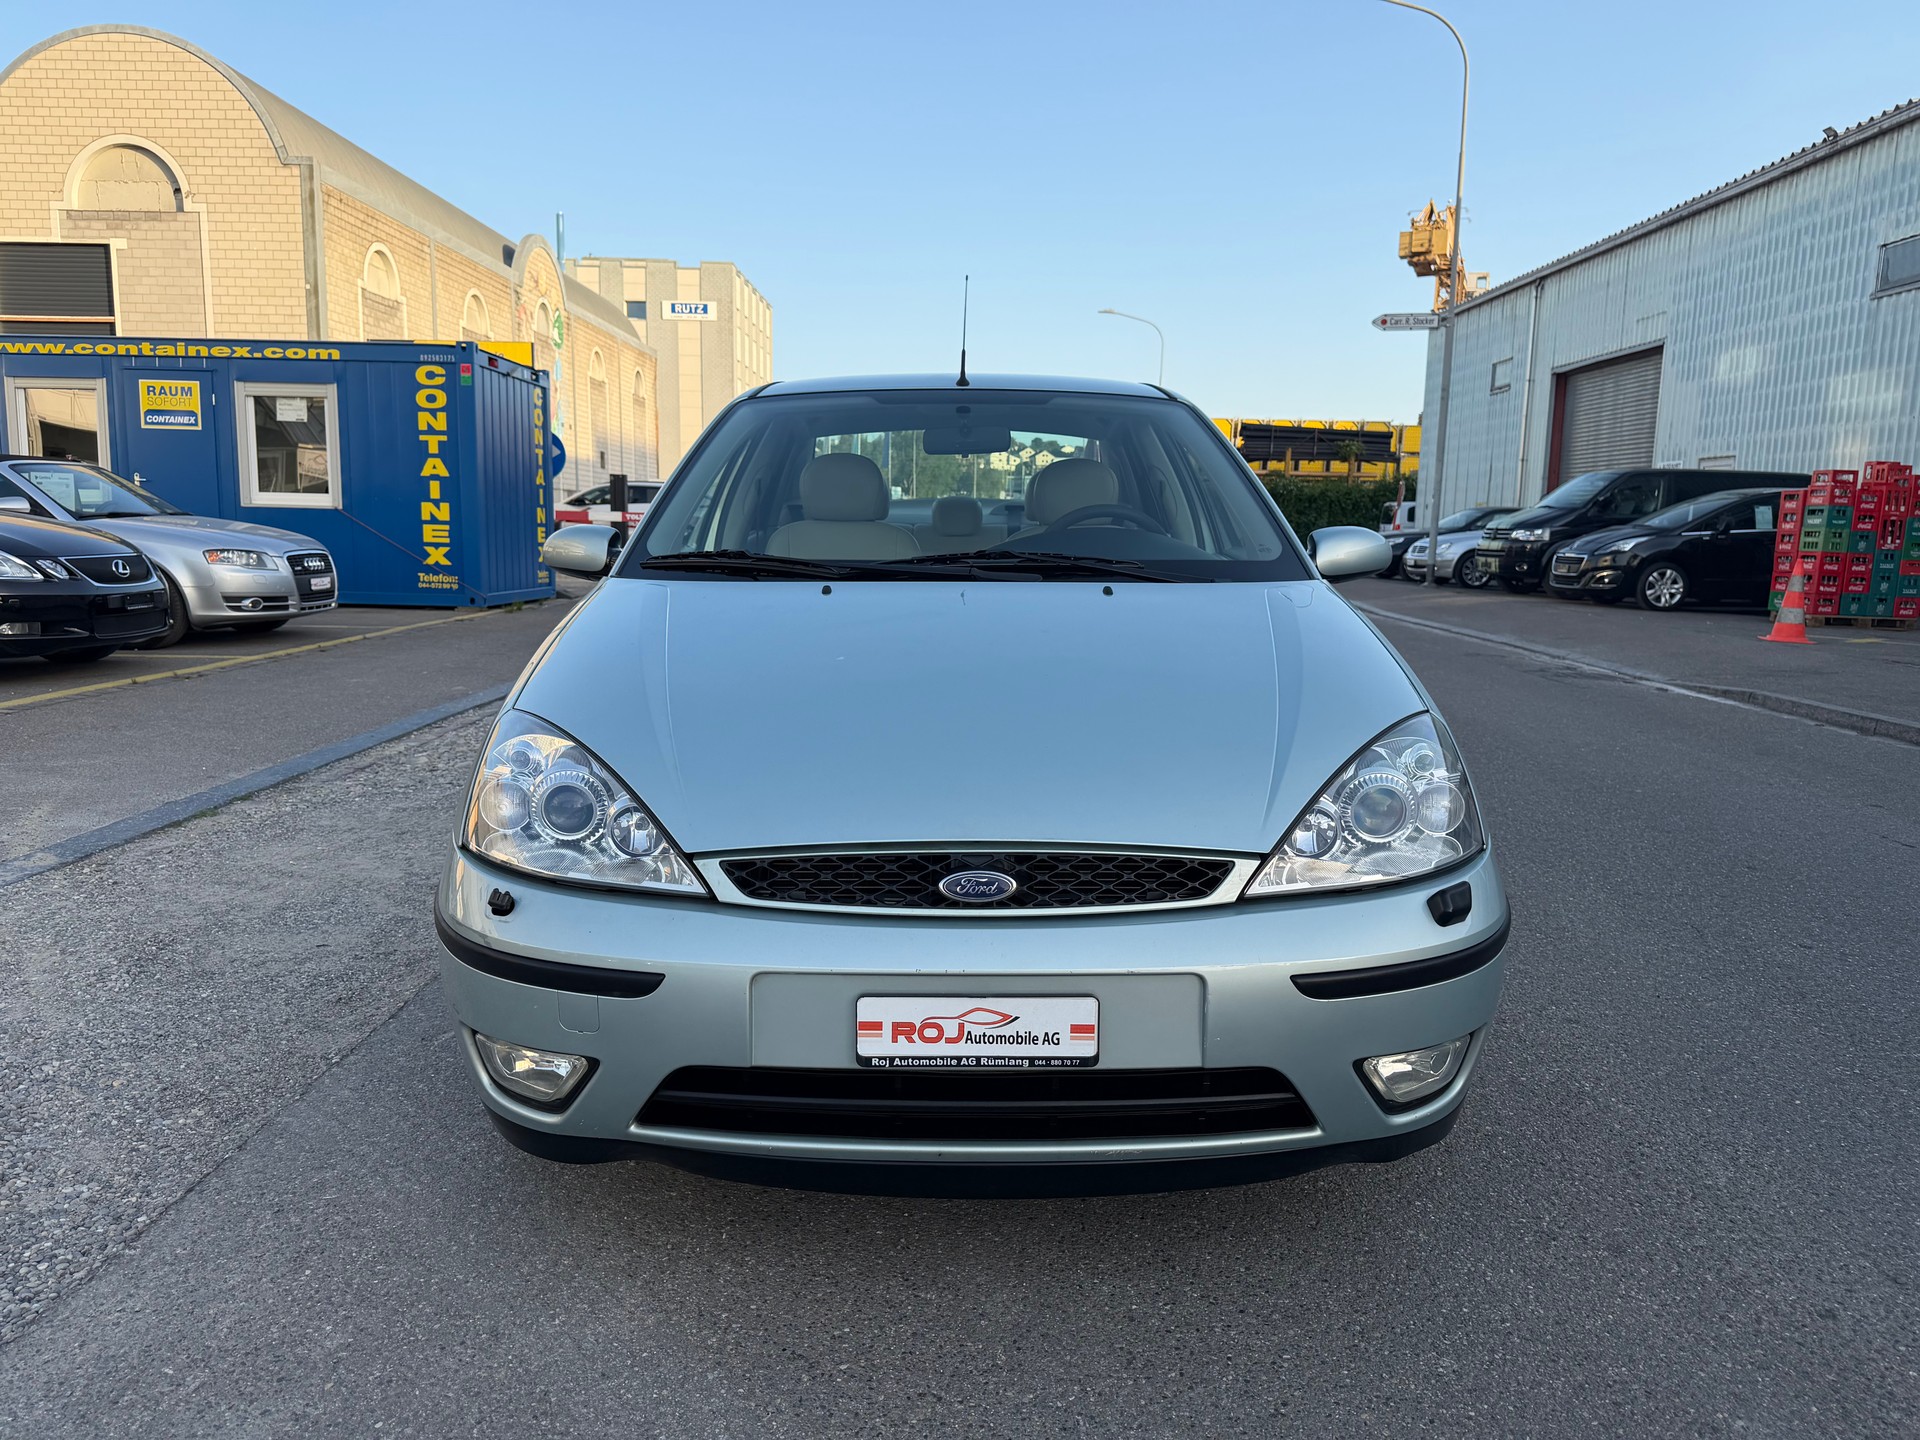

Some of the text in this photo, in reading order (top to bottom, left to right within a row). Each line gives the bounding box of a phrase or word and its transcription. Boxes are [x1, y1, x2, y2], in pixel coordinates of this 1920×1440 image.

[674, 303, 704, 314] RUTZ
[1412, 317, 1435, 325] Stocker
[0, 342, 341, 360] ww.containex.com
[146, 385, 193, 397] RAUM
[146, 396, 193, 407] SOFORT
[146, 415, 196, 424] CONTAINEX
[415, 365, 452, 566] CONTAINEX
[956, 877, 999, 895] Ford
[891, 1021, 1061, 1046] ROJ Automobile AG
[871, 1057, 890, 1068] Roj
[893, 1057, 958, 1067] Automobile
[960, 1057, 977, 1066] AG
[980, 1057, 1029, 1068] Rümlang
